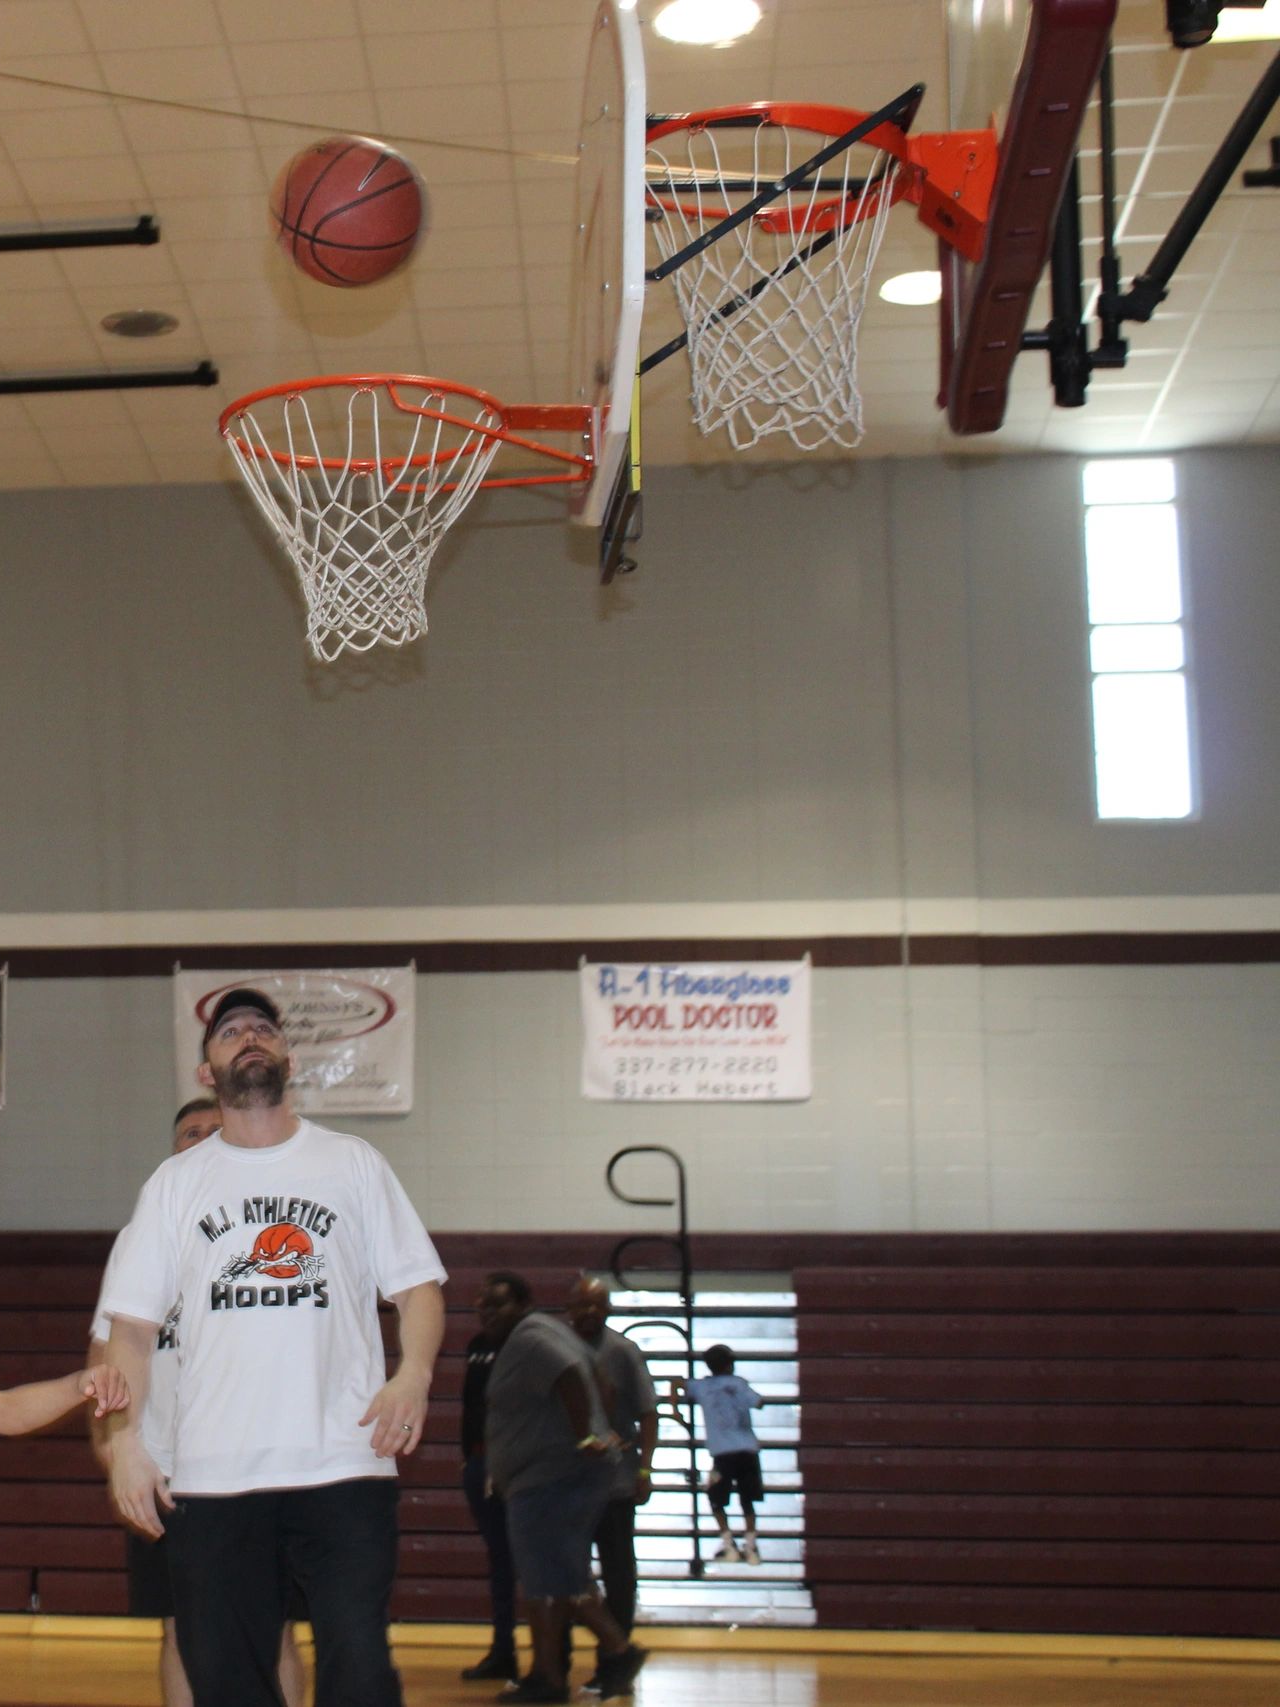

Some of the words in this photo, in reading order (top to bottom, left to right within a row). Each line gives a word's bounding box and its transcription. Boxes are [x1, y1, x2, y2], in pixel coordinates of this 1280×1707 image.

[612, 1003, 674, 1030] POOL
[681, 1003, 778, 1030] DOCTOR
[613, 1056, 778, 1074] 337-277-2220
[243, 1196, 337, 1238] ATHLETICS
[211, 1279, 330, 1311] HOOPS
